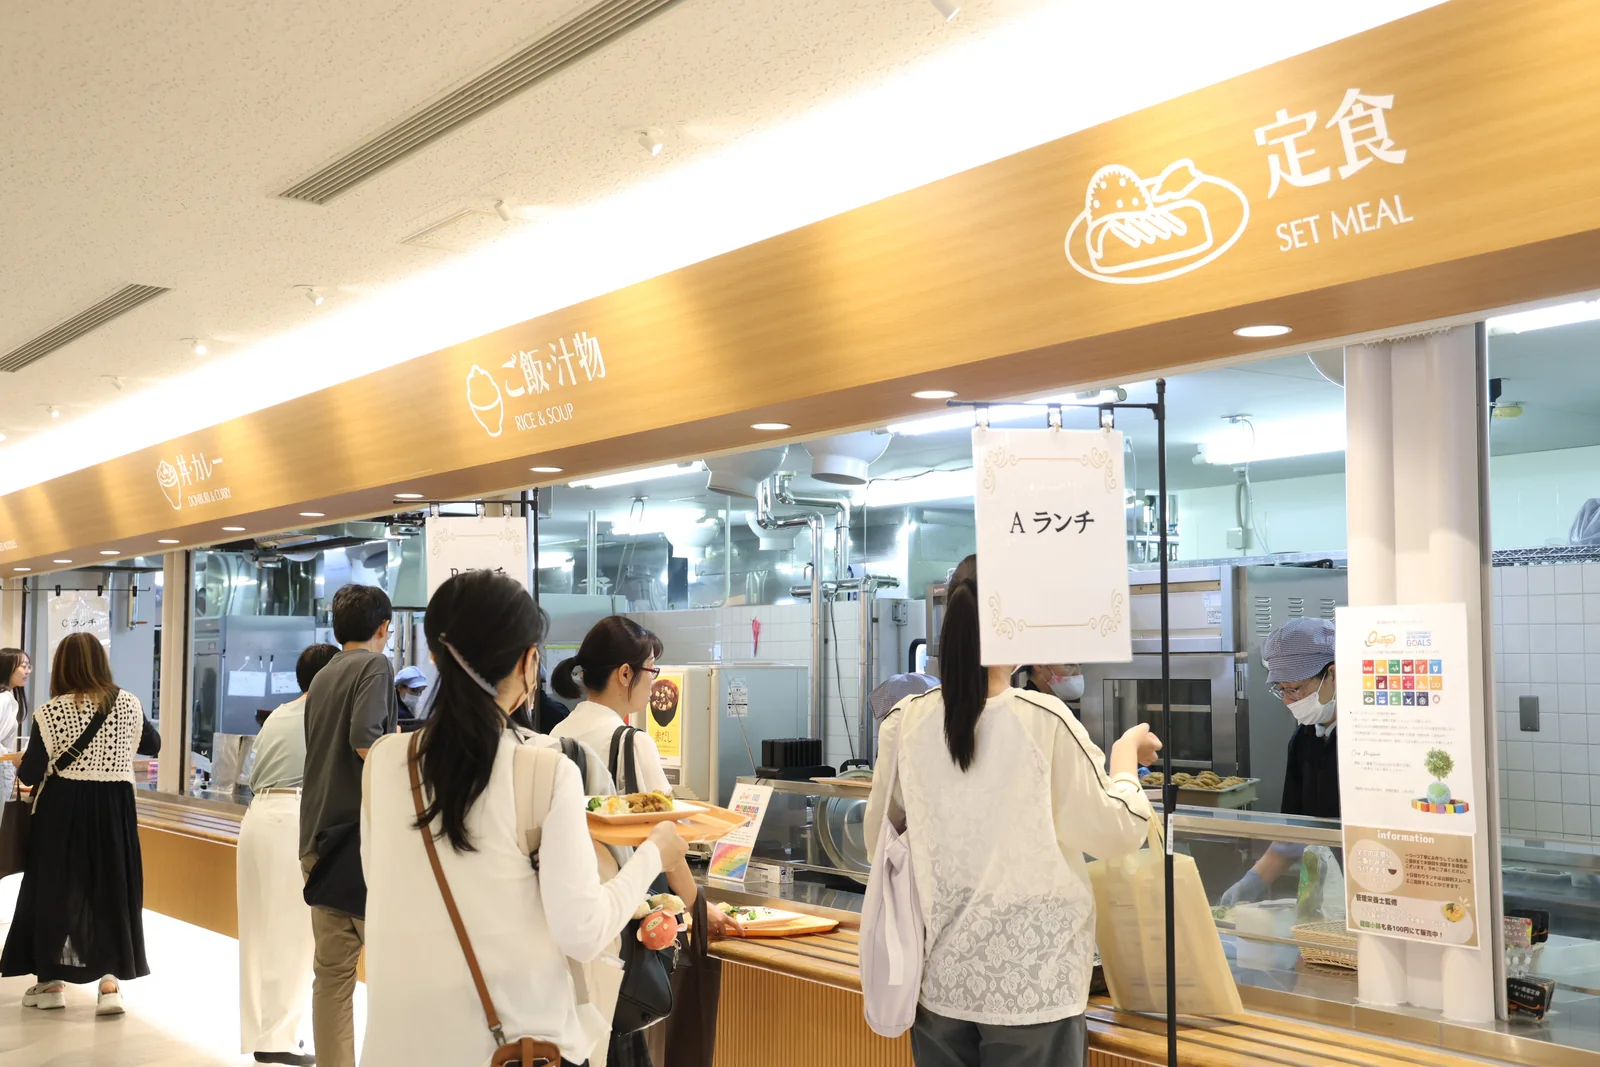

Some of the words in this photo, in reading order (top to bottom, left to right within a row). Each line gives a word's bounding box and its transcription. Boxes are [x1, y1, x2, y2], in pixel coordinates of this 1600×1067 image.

[1253, 88, 1407, 200] 定食
[1276, 214, 1320, 251] SET
[1331, 195, 1414, 240] MEAL
[501, 331, 606, 397] ご飯・汁物
[514, 411, 537, 431] RICE
[537, 410, 547, 426] &
[546, 402, 574, 424] SOUP
[175, 452, 224, 487] 丼・カレー
[187, 491, 211, 507] DONBURI
[214, 486, 232, 501] CURRY
[1009, 511, 1026, 533] A
[1033, 509, 1095, 534] ランチ
[61, 618, 68, 628] C
[71, 618, 97, 628] ランチ
[1406, 639, 1432, 647] GOALS
[1377, 830, 1435, 844] information
[1355, 893, 1398, 906] 管理栄養士監修
